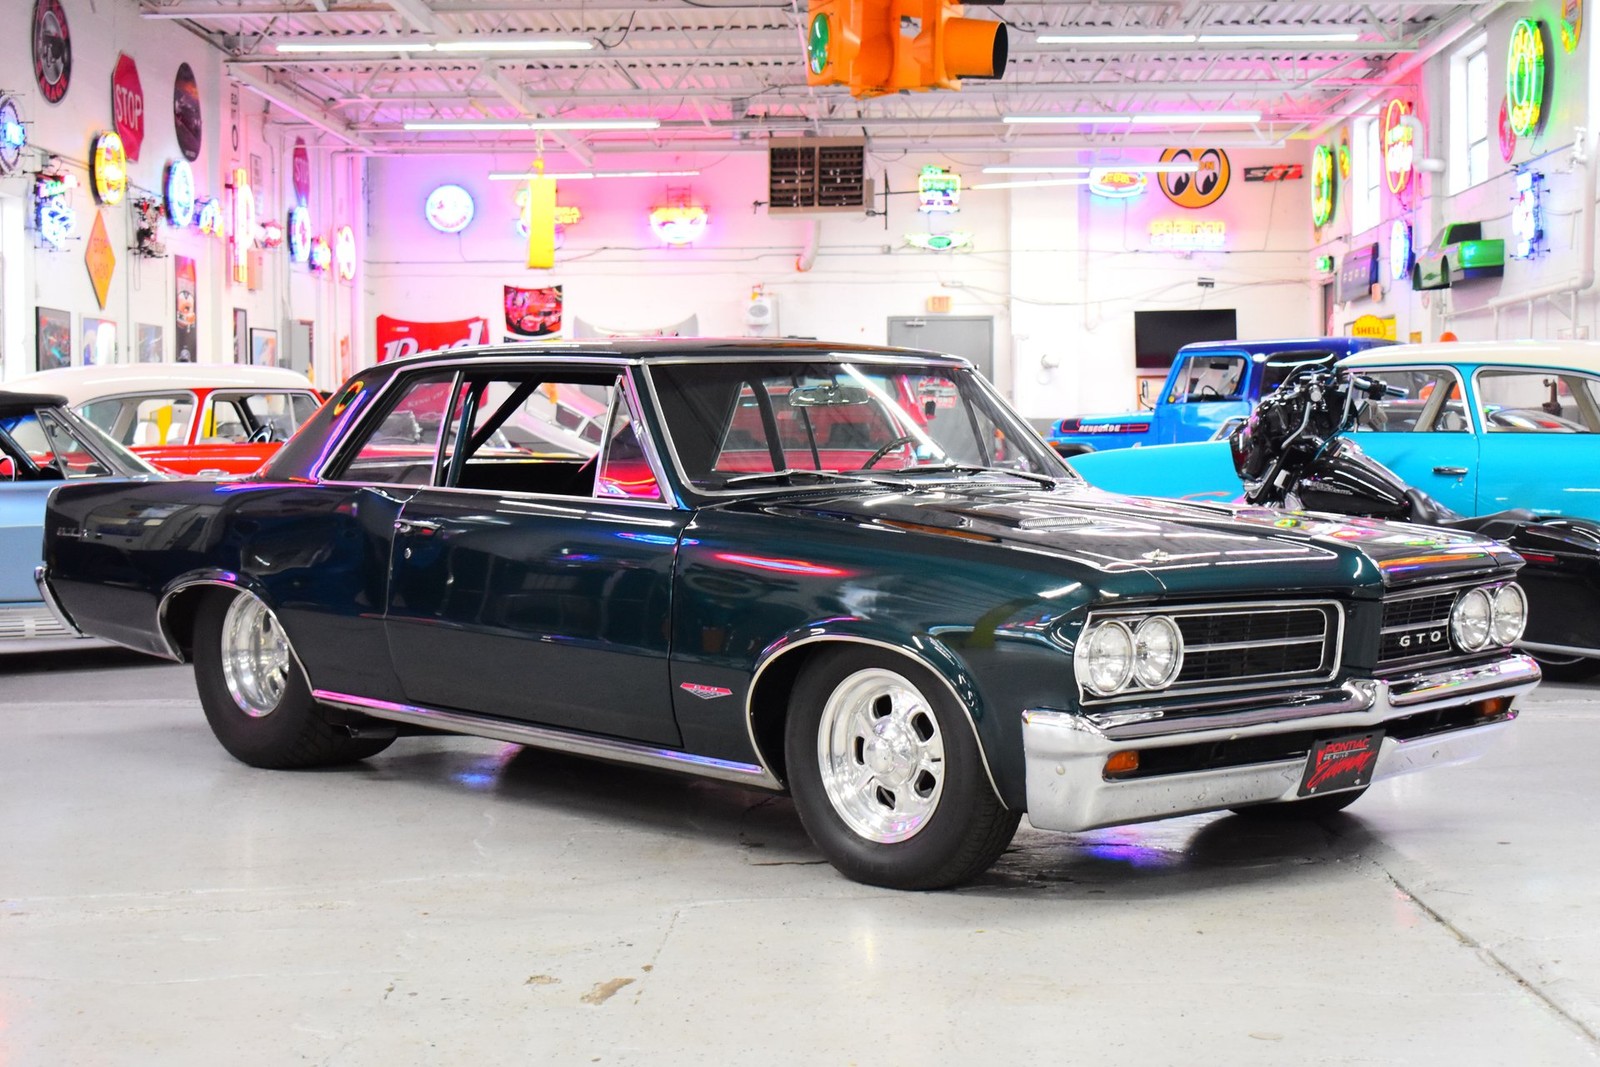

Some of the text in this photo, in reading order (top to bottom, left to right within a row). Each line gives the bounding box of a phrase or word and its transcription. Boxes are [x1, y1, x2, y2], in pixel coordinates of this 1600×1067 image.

[115, 83, 142, 131] STOP
[1246, 167, 1302, 178] SRT
[1356, 326, 1381, 335] SHELL
[1399, 631, 1441, 647] GTO
[1325, 738, 1371, 753] PONTIAC
